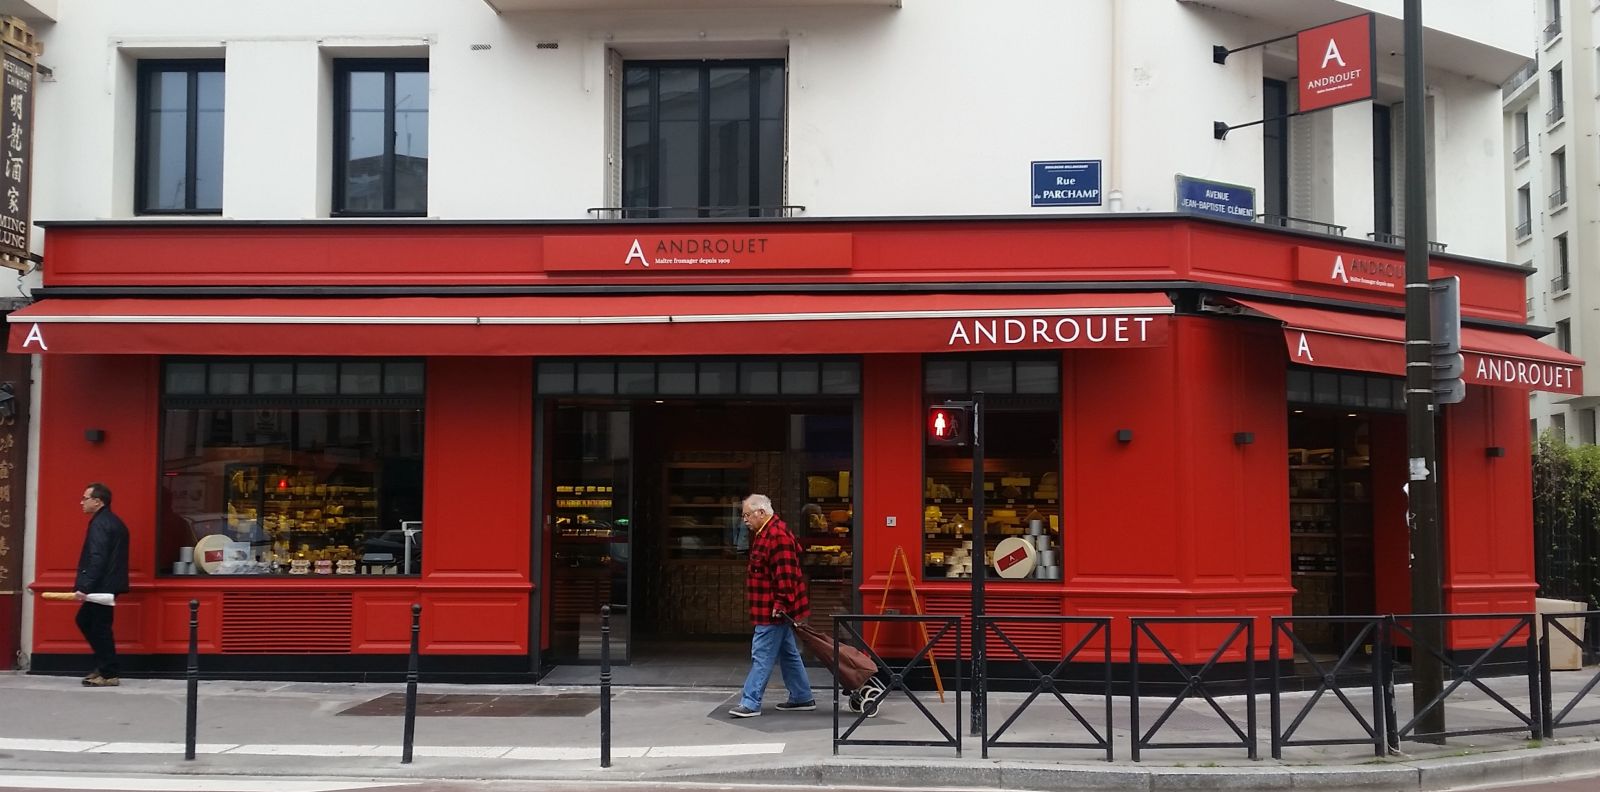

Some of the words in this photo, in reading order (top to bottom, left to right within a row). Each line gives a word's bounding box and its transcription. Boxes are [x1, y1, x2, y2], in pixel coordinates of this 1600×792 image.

[1321, 38, 1346, 69] A
[3, 58, 32, 81] RESTAURANT
[1307, 69, 1361, 90] ANDROUET
[7, 74, 28, 93] CHINOIS
[1056, 176, 1076, 185] Rue
[1043, 189, 1099, 199] PARCHAMP
[1205, 189, 1230, 201] AVENUE
[1181, 198, 1226, 213] JEAN-BAPTISTE
[1227, 205, 1254, 217] CLÉMENT
[0, 213, 26, 234] MING
[624, 238, 649, 267] A
[655, 239, 768, 254] ANDROUET
[673, 257, 699, 265] fromager
[699, 257, 717, 265] depuis
[1331, 255, 1349, 284] A
[1350, 258, 1405, 279] ANDROU
[22, 322, 48, 351] A
[948, 317, 1154, 345] ANDROUET
[1297, 332, 1313, 362] A
[1476, 357, 1574, 389] ANDROUET
